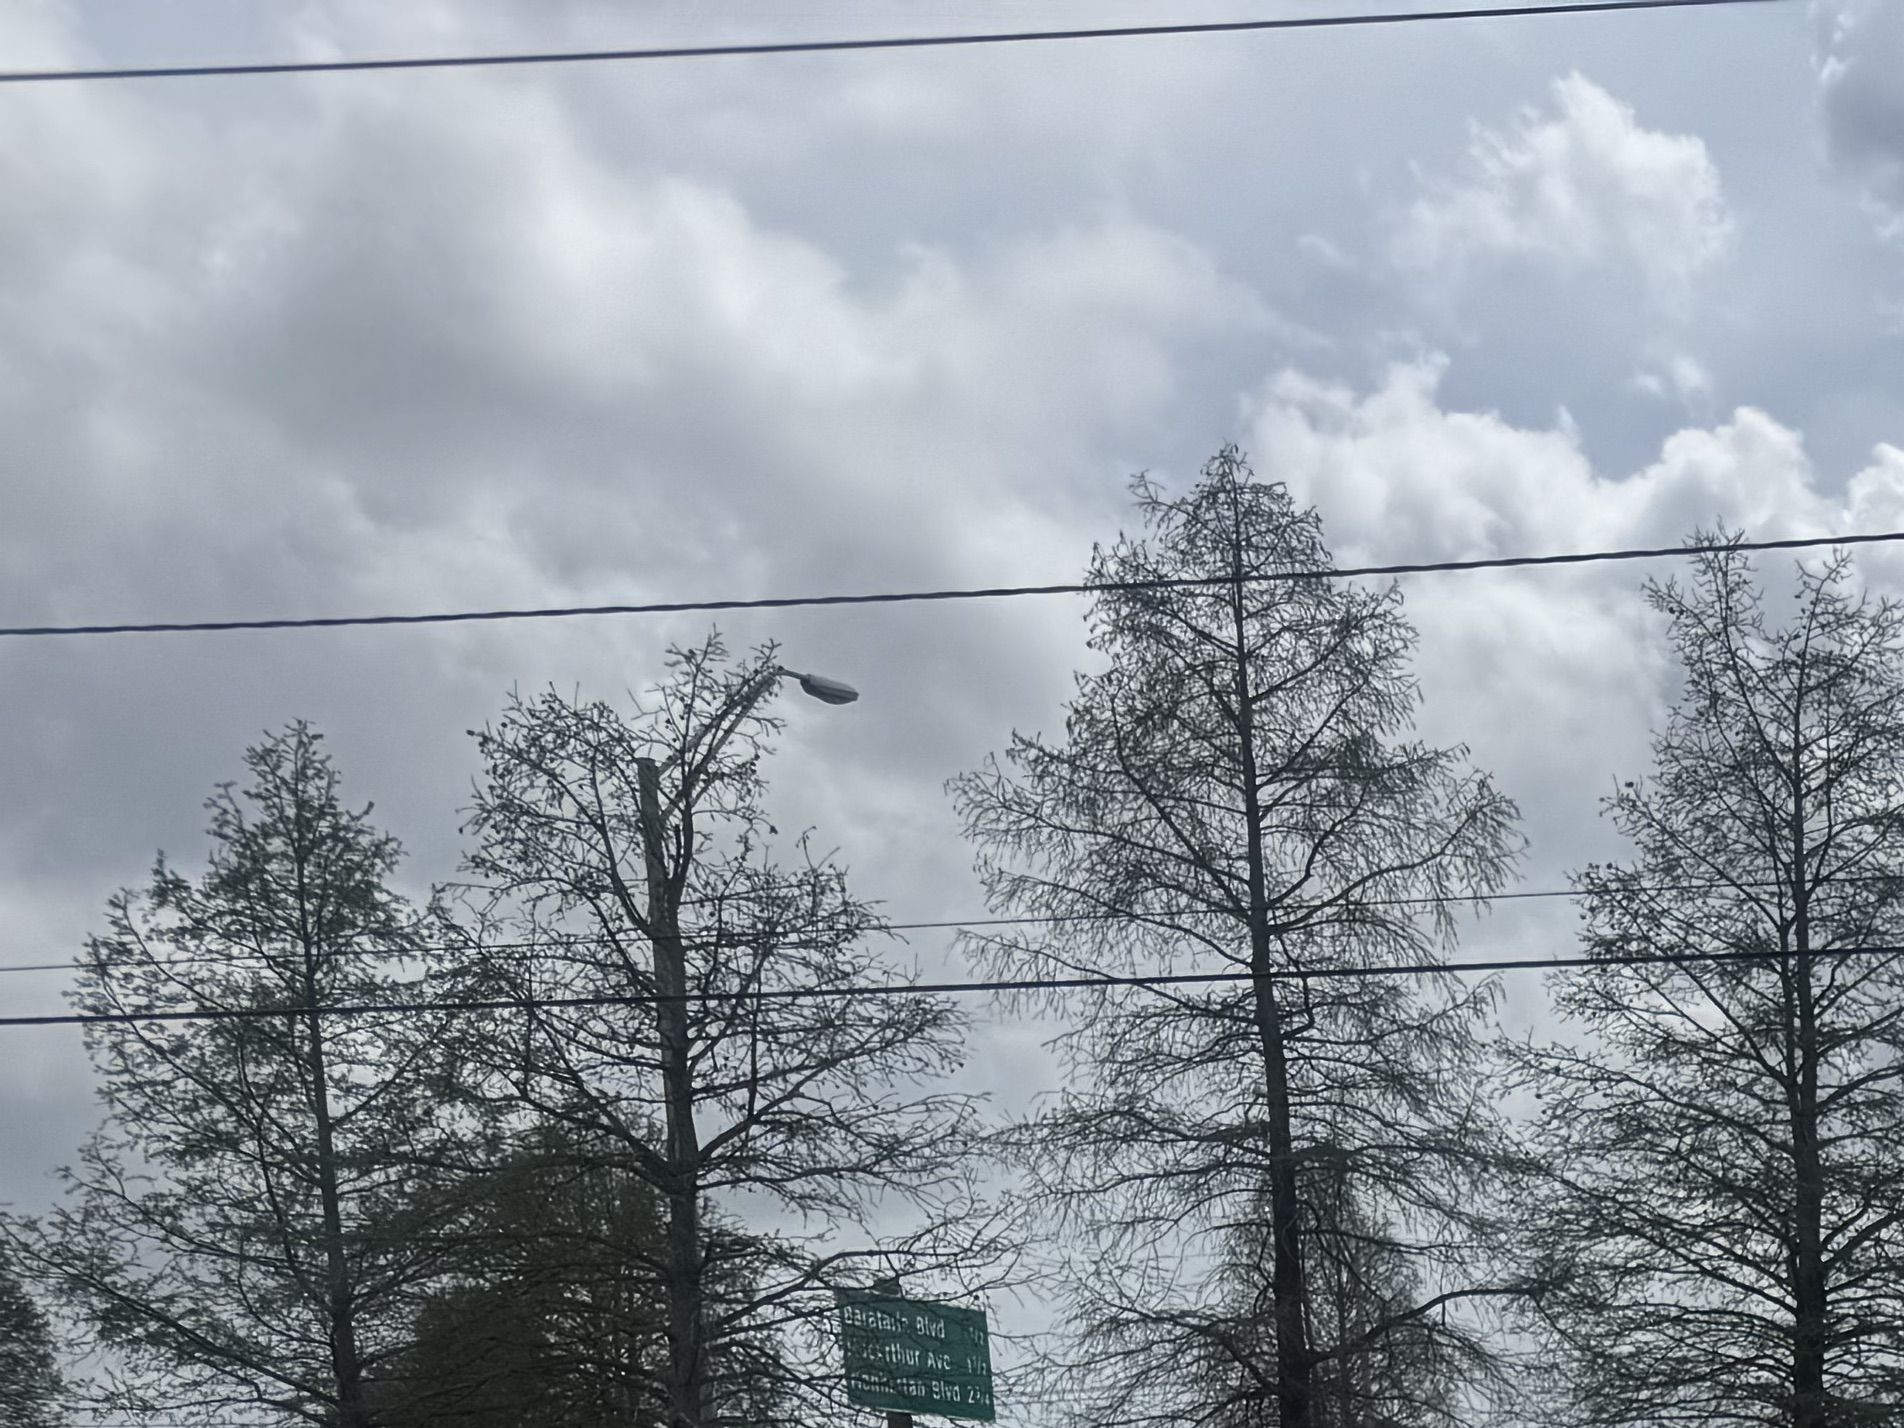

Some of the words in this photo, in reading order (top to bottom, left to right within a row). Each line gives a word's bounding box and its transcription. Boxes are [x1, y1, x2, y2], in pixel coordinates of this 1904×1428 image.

[916, 1316, 945, 1338] Blvd
[927, 1352, 951, 1370] Ave
[931, 1380, 961, 1402] Blvd
